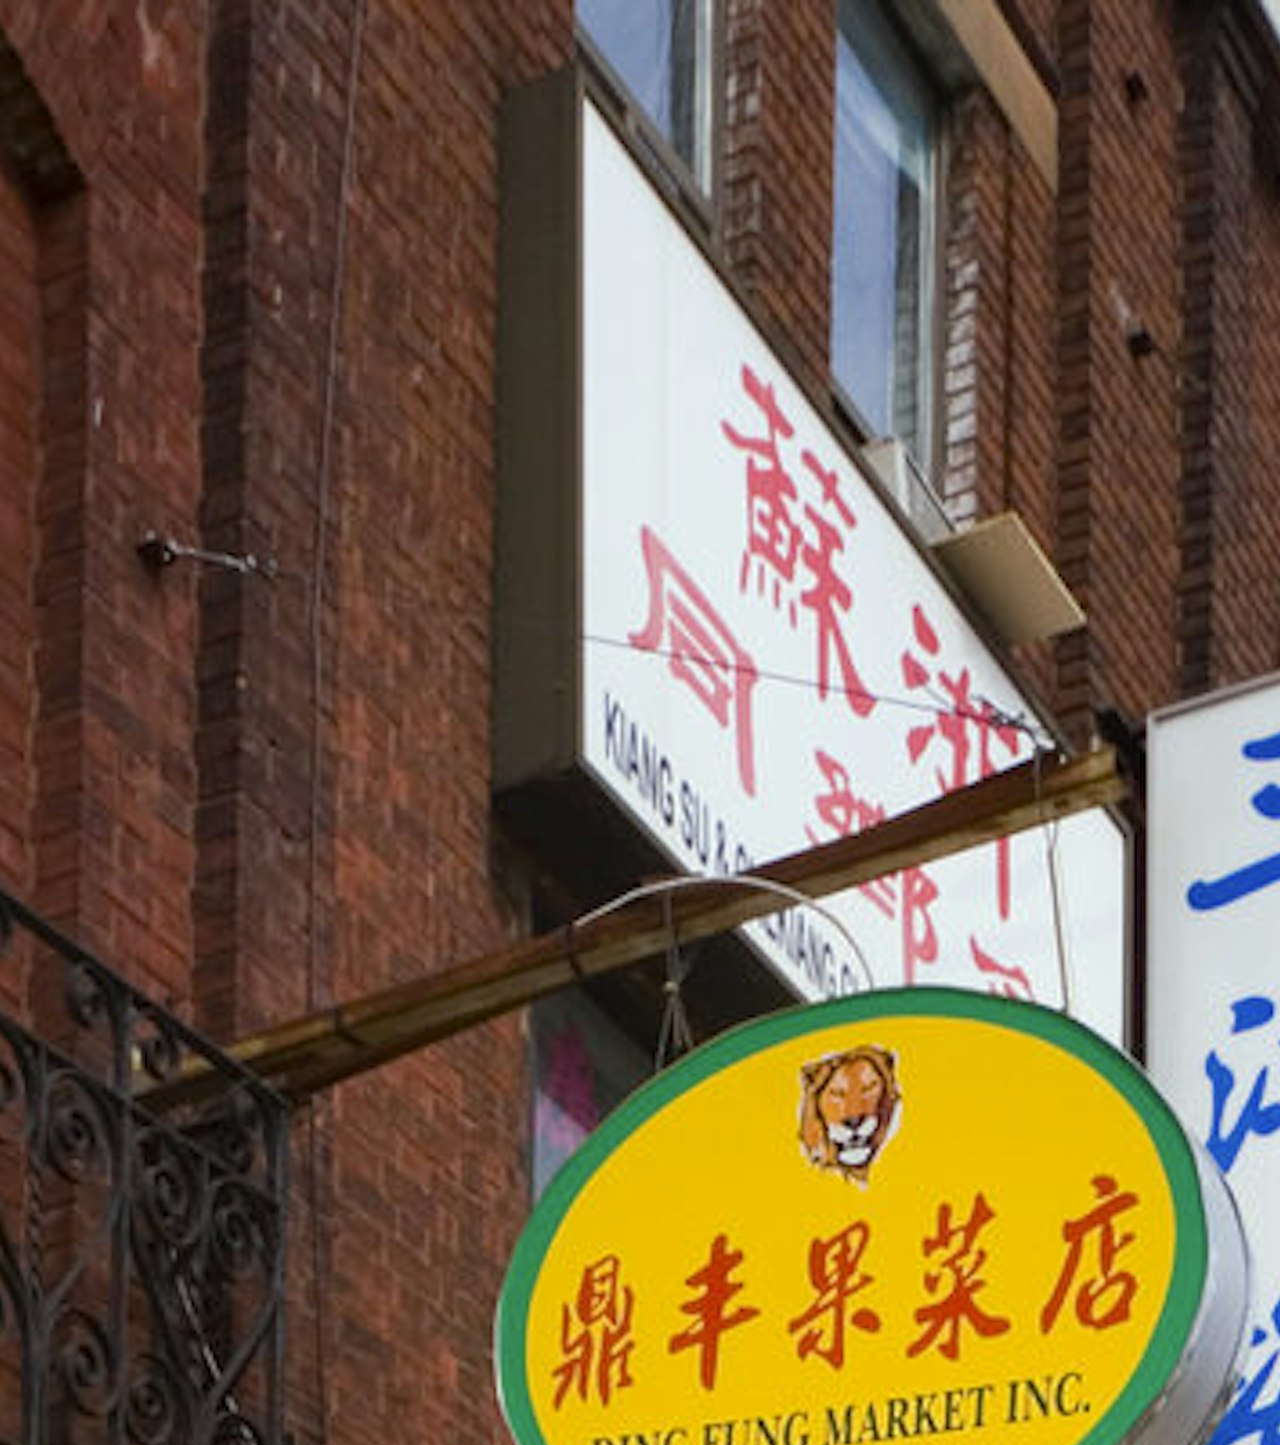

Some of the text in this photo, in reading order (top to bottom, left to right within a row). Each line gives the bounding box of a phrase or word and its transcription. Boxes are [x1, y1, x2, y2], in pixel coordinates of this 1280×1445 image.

[605, 693, 675, 828] KIANG
[680, 780, 709, 867] SU
[1004, 1371, 1093, 1425] INC.
